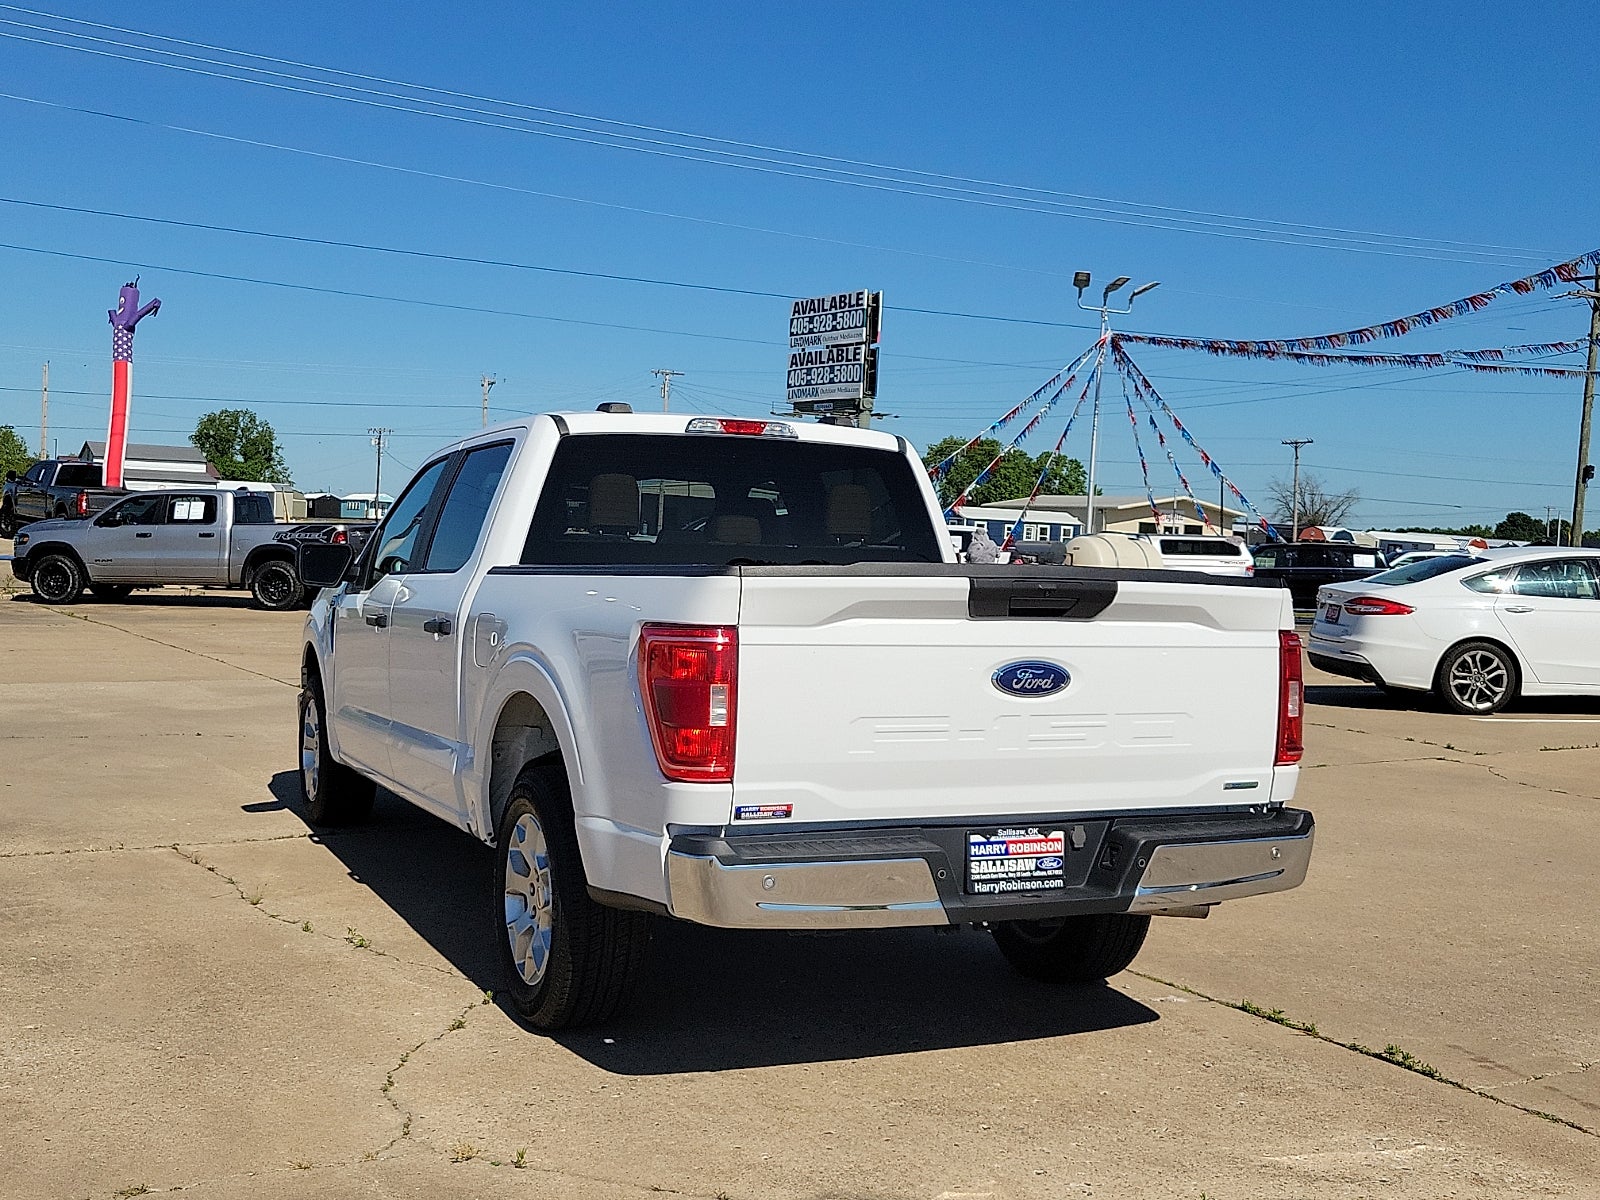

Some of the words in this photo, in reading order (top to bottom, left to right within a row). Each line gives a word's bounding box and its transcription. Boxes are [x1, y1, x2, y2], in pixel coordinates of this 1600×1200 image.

[792, 292, 864, 316] AVAILABLE
[791, 310, 863, 334] 405-928-5800
[790, 335, 822, 348] LINDMARK
[790, 347, 861, 368] AVAILABLE
[788, 365, 860, 386] 405-928-5800
[788, 387, 820, 399] LINDMARK
[1012, 669, 1054, 689] Ford
[971, 844, 1006, 855] HARRY
[1009, 841, 1061, 853] ROBINSON
[971, 858, 1036, 874] SALLISAW
[1042, 857, 1058, 867] Ford
[974, 879, 1063, 893] HarryRobinson.com
